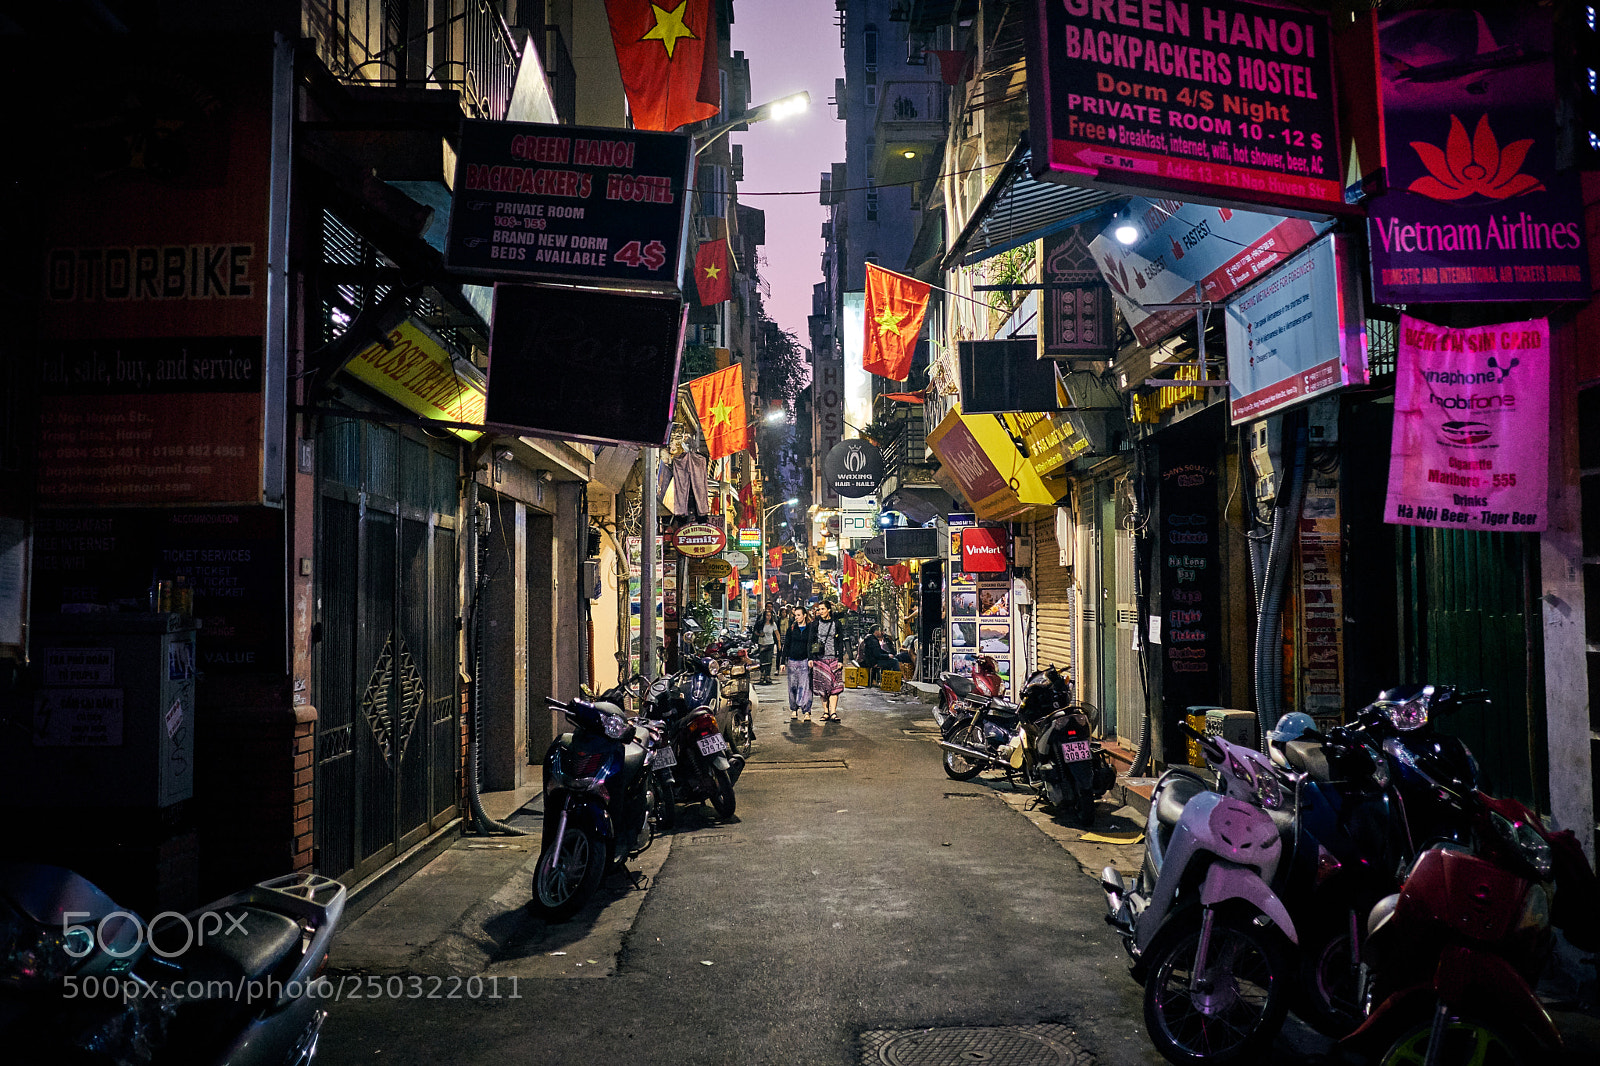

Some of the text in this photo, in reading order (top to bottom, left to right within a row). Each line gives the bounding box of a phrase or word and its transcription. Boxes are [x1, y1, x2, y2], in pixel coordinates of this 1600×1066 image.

[1203, 7, 1316, 58] HANOI
[1065, 24, 1318, 100] BACKPACKERS HOSTEL
[1096, 72, 1291, 125] Dorm 4/$ Night
[1068, 93, 1162, 125] PRIVATE
[1169, 110, 1232, 135] ROOM
[1238, 122, 1263, 141] 10
[1281, 128, 1305, 148] 12
[511, 134, 635, 168] GREEN HANOI
[1068, 115, 1106, 141] Free
[1118, 125, 1168, 151] Breakfast,
[1169, 133, 1211, 158] internet,
[1233, 144, 1250, 163] hot
[1250, 147, 1286, 172] shower,
[1286, 152, 1309, 175] beer,
[1311, 155, 1324, 174] AC
[465, 163, 674, 204] BACKPACKER'S HOSTEL
[1166, 161, 1194, 180] Add:
[1199, 167, 1212, 184] 13
[1224, 169, 1238, 186] 15
[495, 202, 585, 220] PRIVATE ROOM
[493, 230, 608, 251] BRAND NEW DORM
[1183, 219, 1211, 250] FASTEST
[1375, 211, 1580, 253] Vietnam Airlines
[491, 246, 607, 267] BEDS AVAILABLE
[613, 240, 666, 271] 4$
[50, 246, 254, 300] OTORBIKE
[1422, 267, 1438, 284] AND
[1439, 266, 1498, 284] INTERNATIONAL
[1469, 331, 1496, 353] SIM
[1501, 331, 1541, 350] CARD
[43, 348, 252, 389] tal, sale, buy, and service
[1430, 393, 1515, 410] mobifone
[824, 368, 839, 499] HOSTL
[1428, 469, 1516, 487] Marlboro 555
[1453, 494, 1488, 507] Drinks
[1398, 505, 1537, 526] Hà Nội Beer Tiger Beer
[678, 535, 719, 544] Family
[163, 549, 252, 563] TICKET SERVICES
[1184, 556, 1206, 568] Long
[195, 566, 231, 576] TICKET
[204, 651, 256, 664] VALUE
